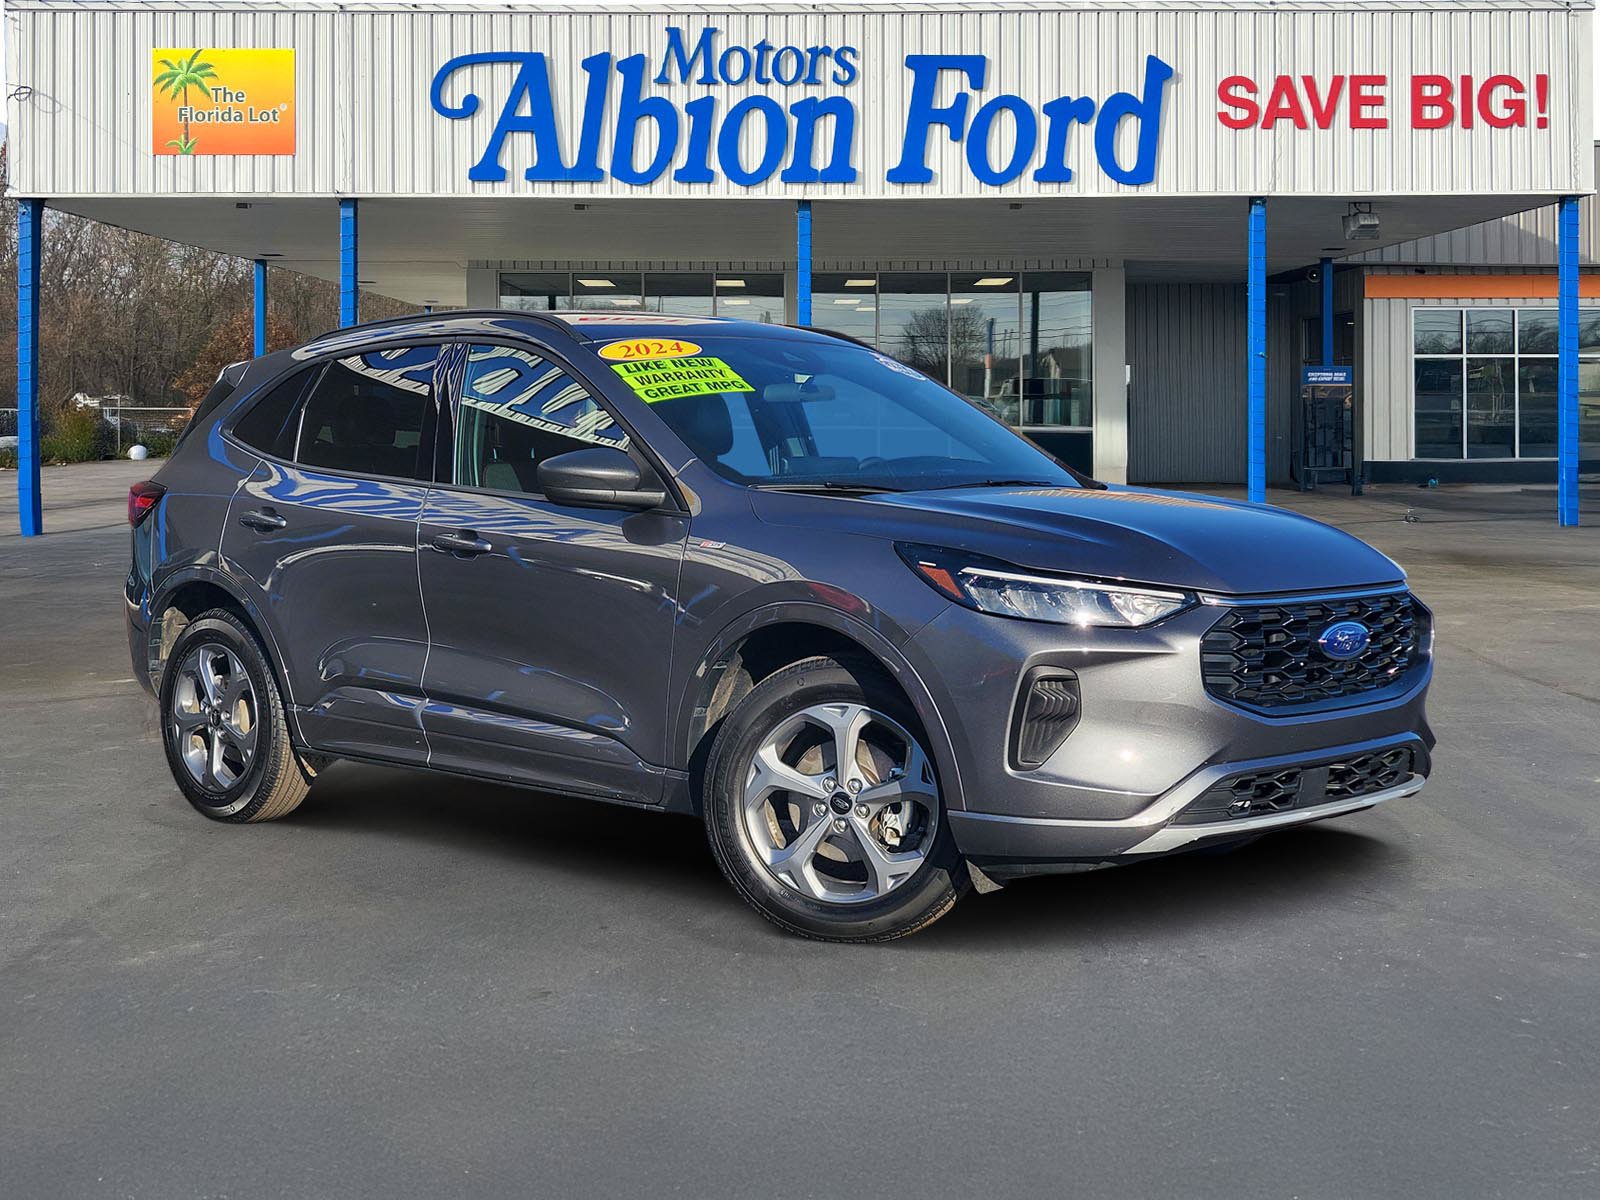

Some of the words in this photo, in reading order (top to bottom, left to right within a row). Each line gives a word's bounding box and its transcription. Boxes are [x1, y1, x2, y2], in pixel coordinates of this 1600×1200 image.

[655, 27, 857, 86] Motors
[211, 86, 246, 103] The
[1218, 75, 1388, 129] SAVE
[1410, 73, 1549, 129] BIG!
[178, 106, 244, 122] Florida
[430, 51, 858, 186] Albion
[886, 54, 1173, 186] Ford
[618, 341, 684, 359] 2024
[623, 358, 668, 375] LIKE
[670, 357, 714, 369] NEW
[634, 368, 726, 387] WARRANTY
[644, 381, 702, 399] GREAT
[706, 379, 746, 393] MPG
